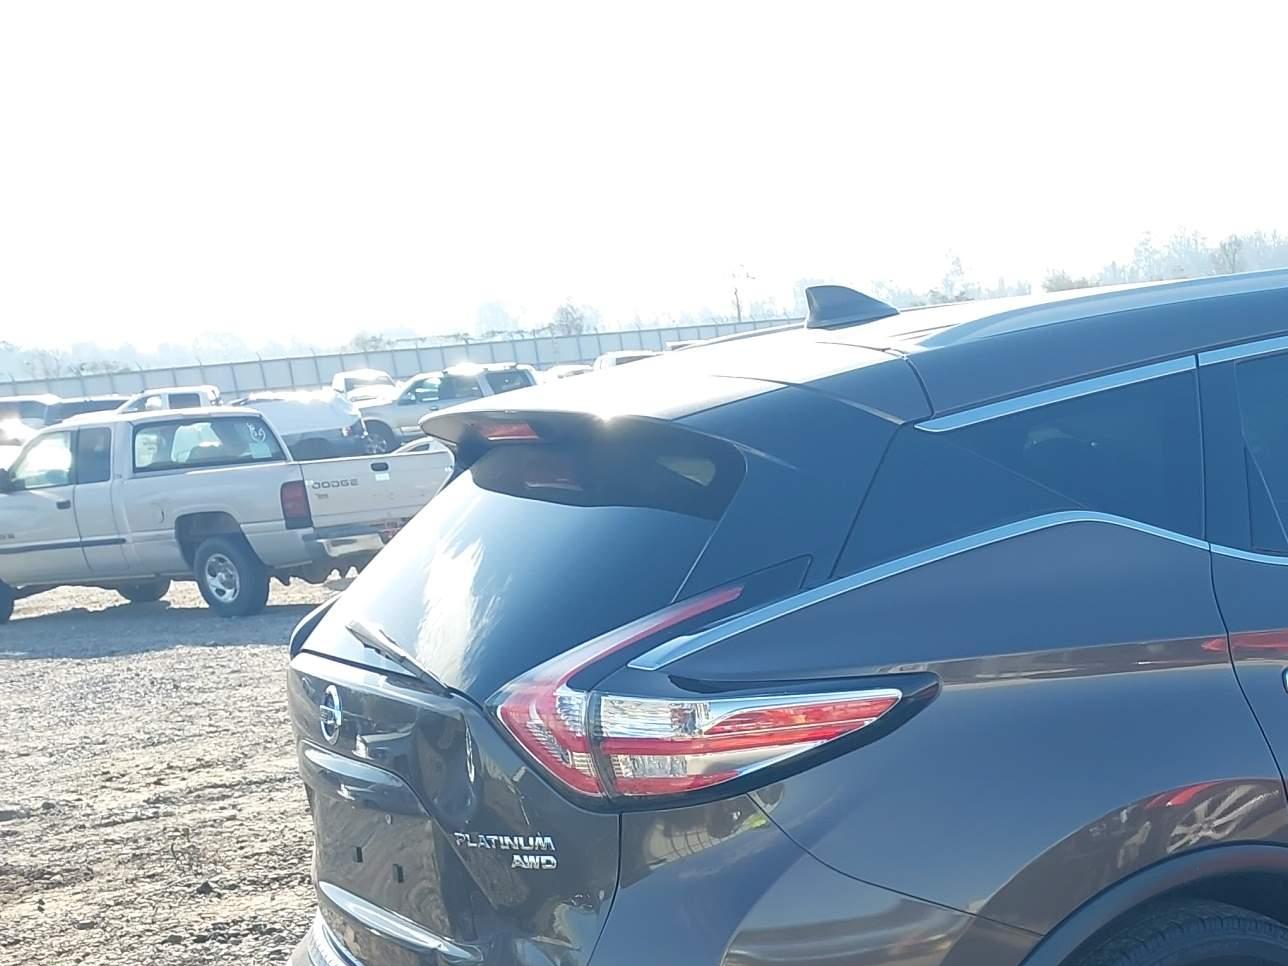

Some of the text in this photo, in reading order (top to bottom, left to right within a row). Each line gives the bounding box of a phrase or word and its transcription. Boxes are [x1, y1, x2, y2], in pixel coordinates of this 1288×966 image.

[311, 478, 360, 490] DODGE
[453, 831, 556, 852] PLATINUM
[511, 854, 558, 870] AWD
